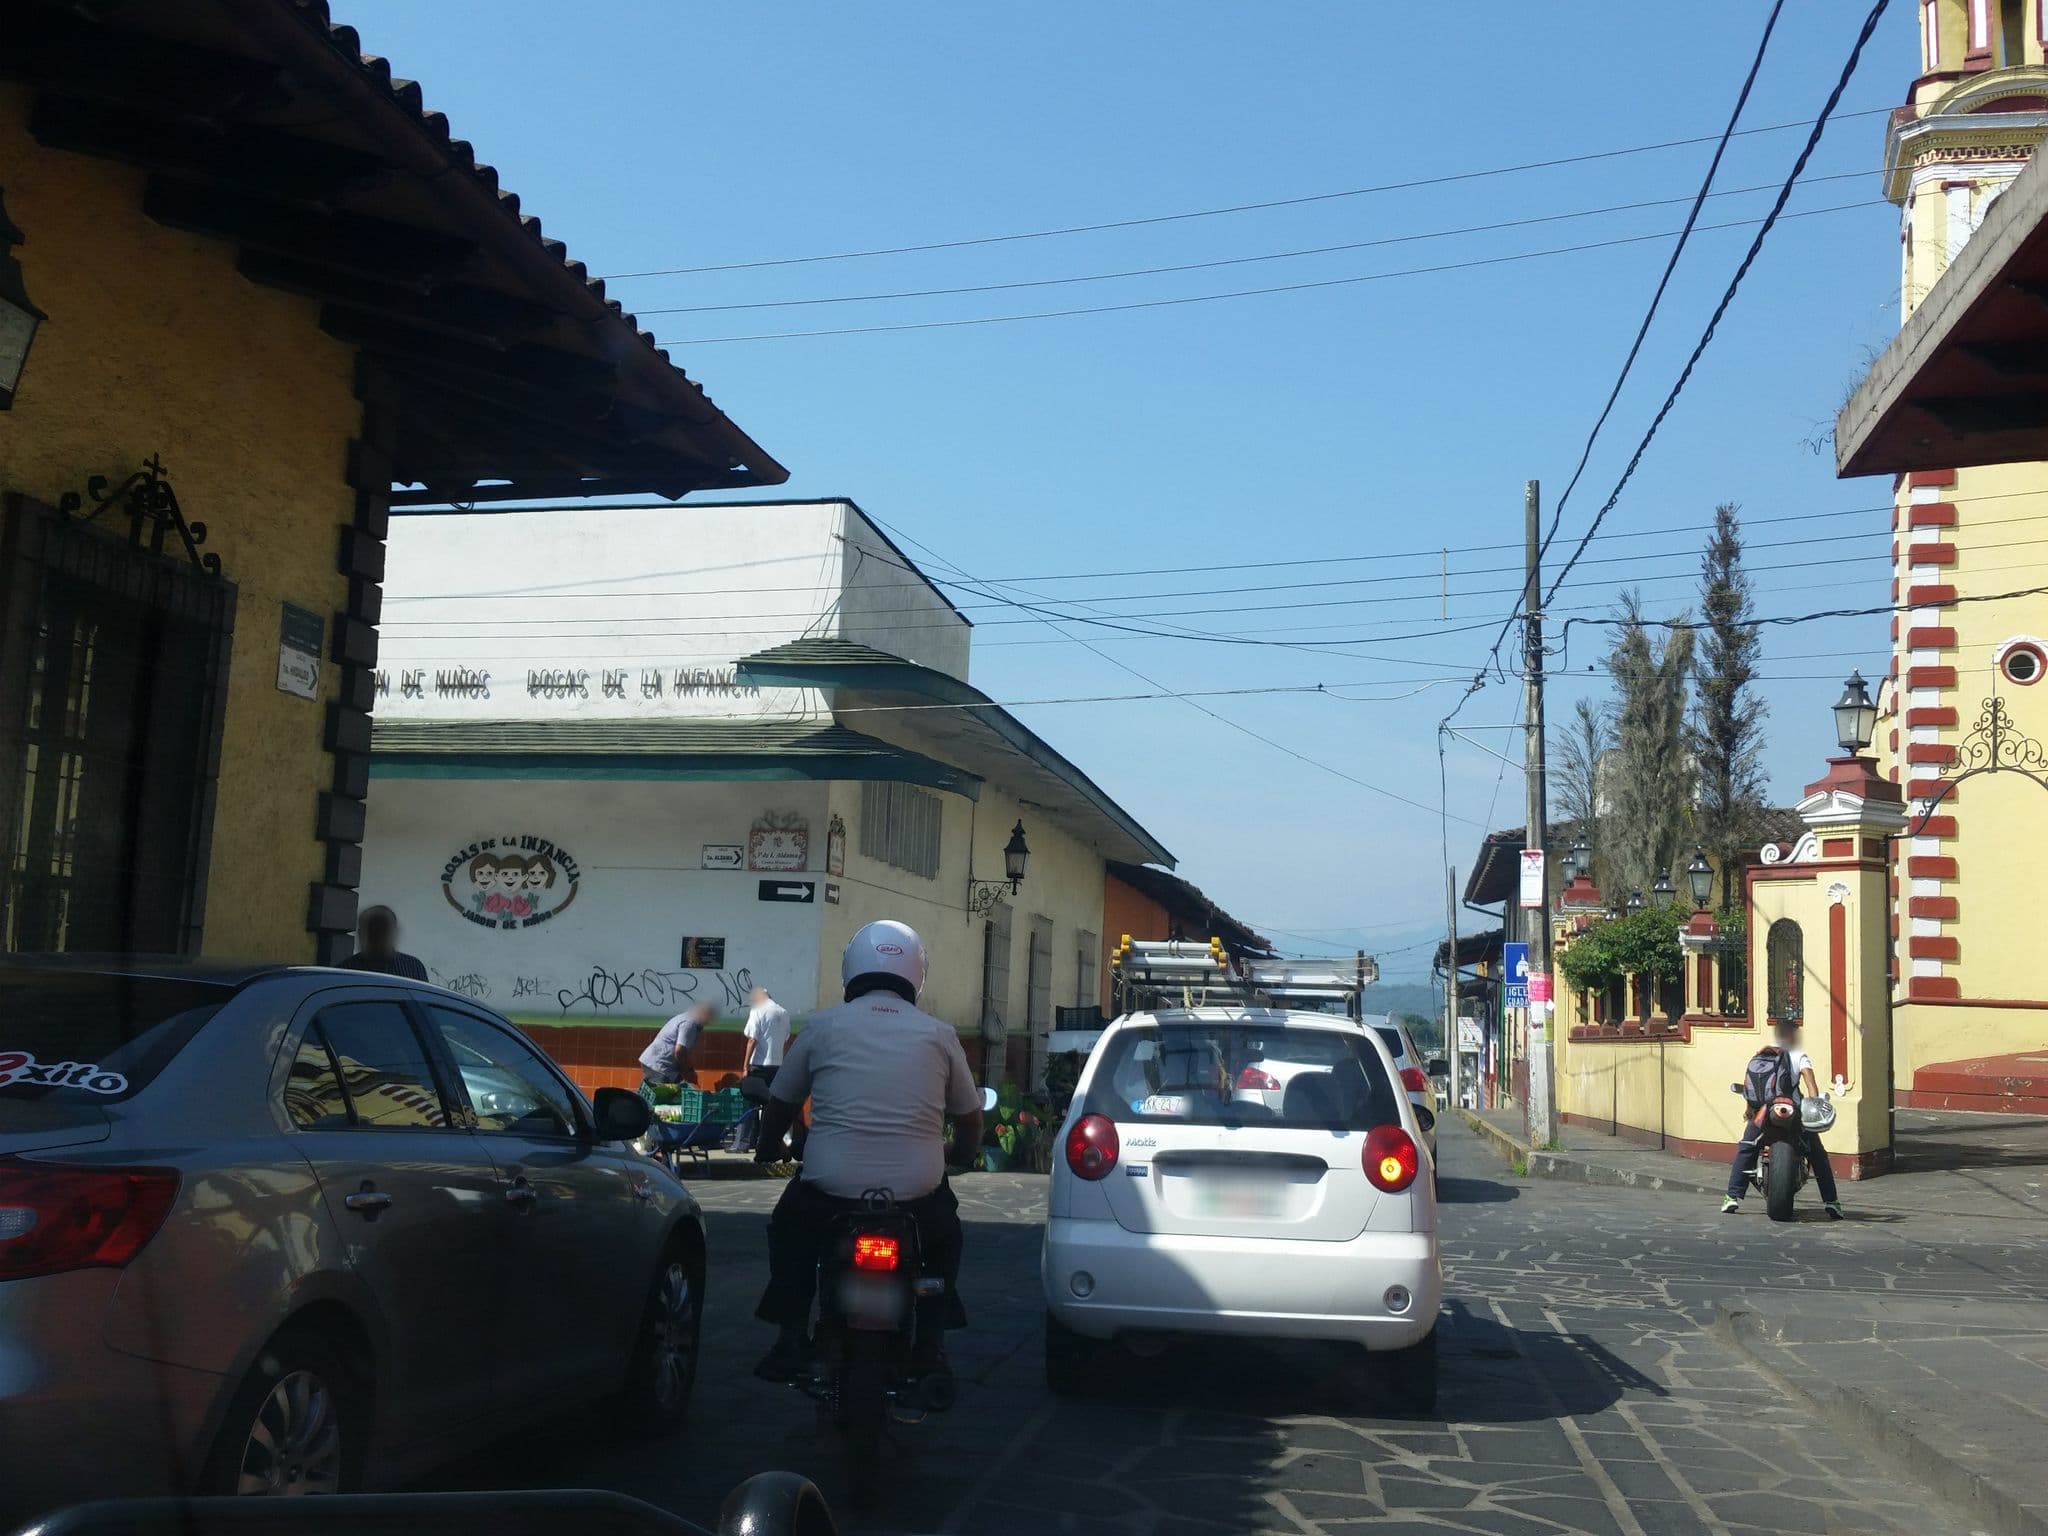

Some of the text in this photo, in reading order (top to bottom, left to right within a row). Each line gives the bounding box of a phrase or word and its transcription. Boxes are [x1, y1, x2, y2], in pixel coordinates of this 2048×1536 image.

[401, 668, 426, 699] DE
[526, 668, 592, 699] ROSAS
[602, 668, 629, 699] DE
[640, 668, 663, 699] LA
[441, 835, 581, 884] ROSAS DE LA INFANCIA
[1126, 1136, 1157, 1147] Matiz
